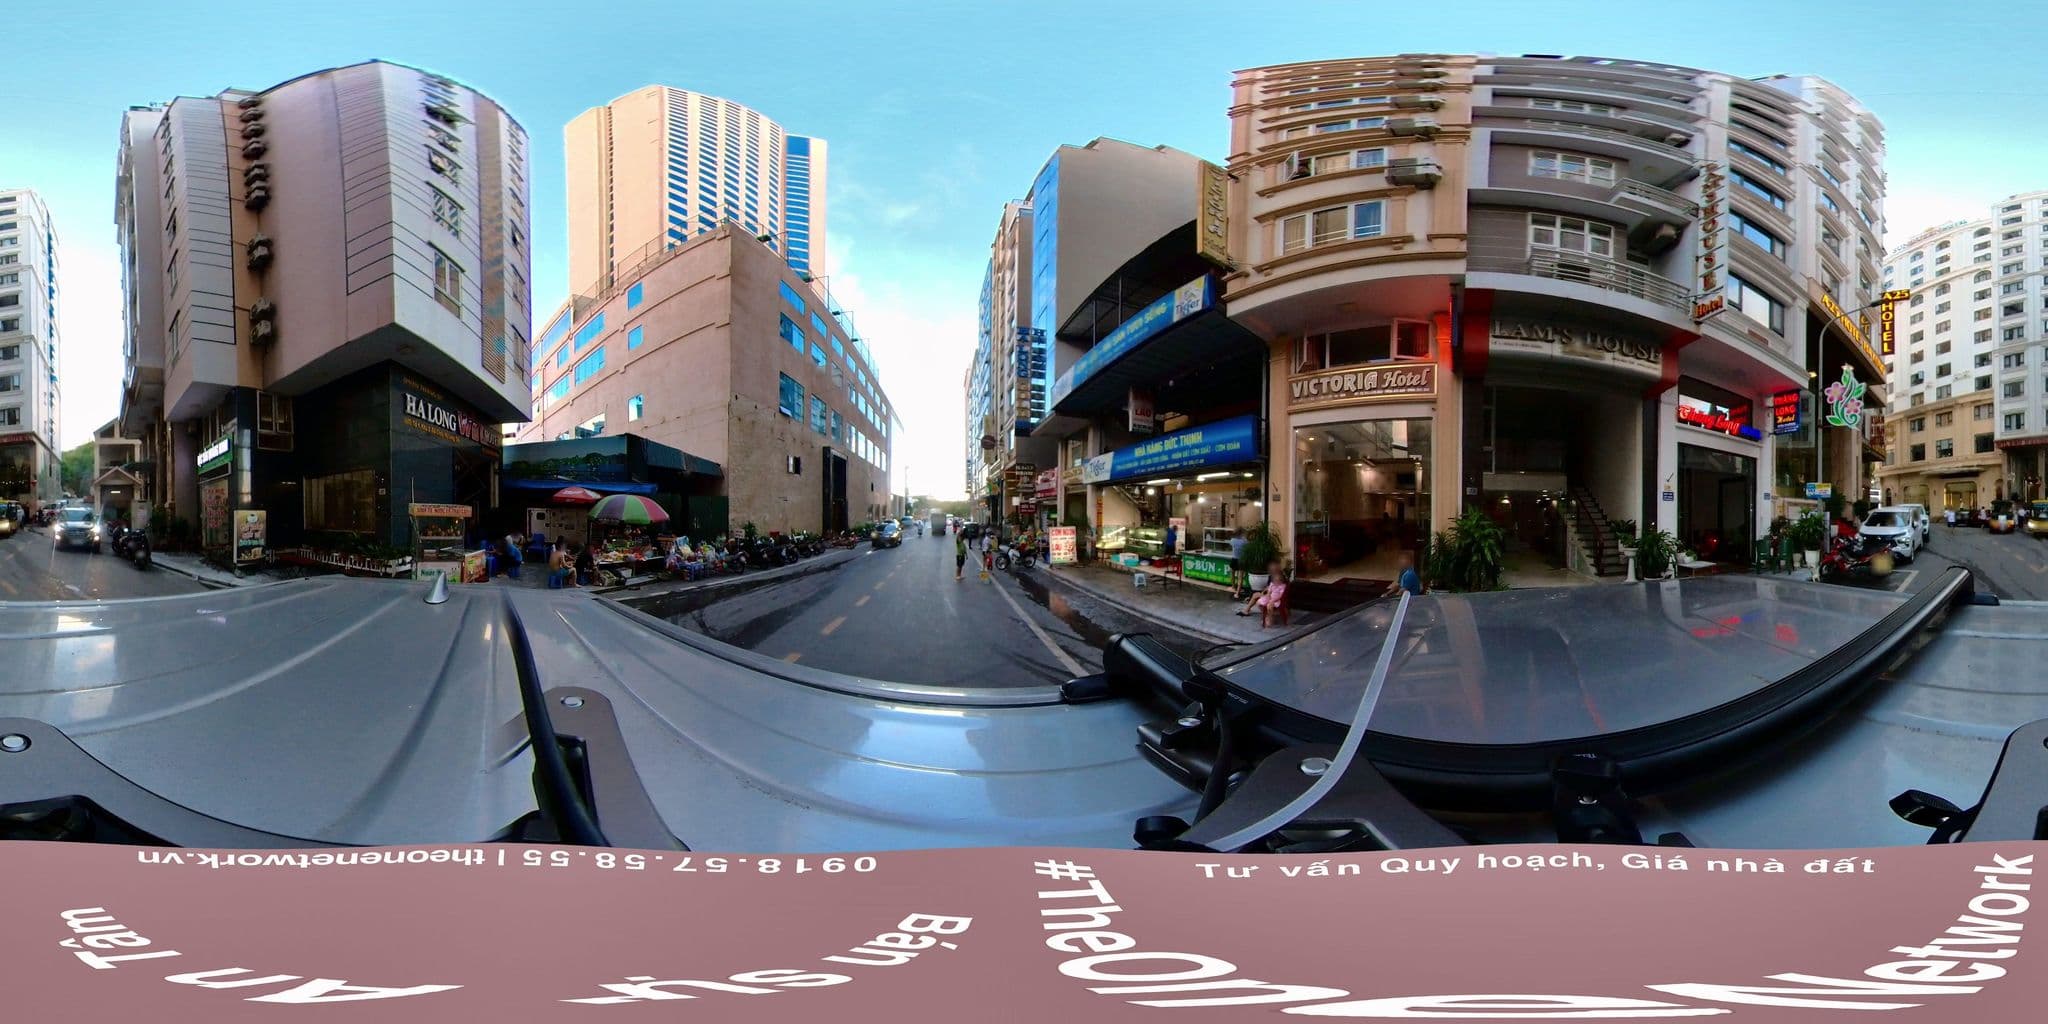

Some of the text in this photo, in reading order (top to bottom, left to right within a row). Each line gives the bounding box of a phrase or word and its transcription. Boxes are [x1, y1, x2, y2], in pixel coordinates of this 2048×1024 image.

[1175, 300, 1201, 316] Tiger
[1695, 295, 1723, 319] Hotel
[1821, 294, 1841, 317] A25
[1881, 289, 1909, 353] A25 HOTEL
[1492, 320, 1574, 344] LAM'S
[1586, 330, 1662, 363] HOUSE
[1292, 371, 1378, 398] VICTORIA
[1381, 367, 1431, 388] Hotel
[1775, 404, 1796, 416] LONG
[1195, 558, 1216, 573] BÚN
